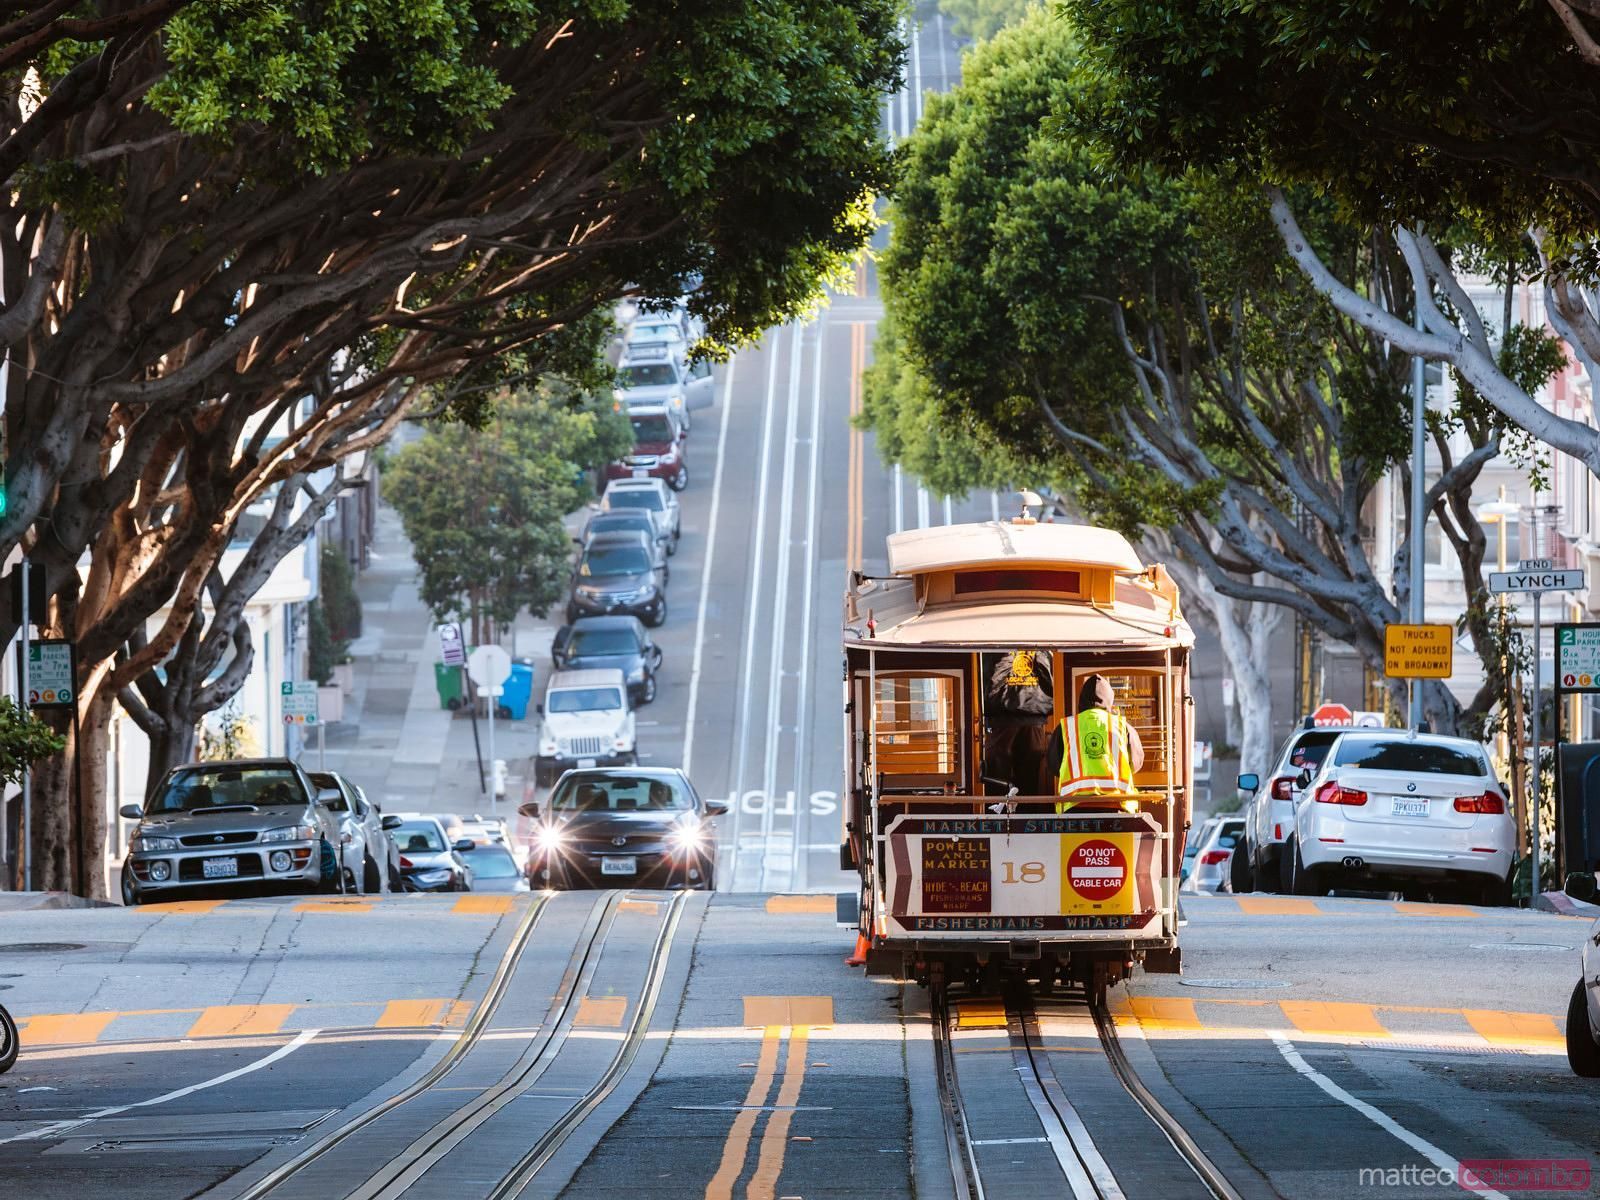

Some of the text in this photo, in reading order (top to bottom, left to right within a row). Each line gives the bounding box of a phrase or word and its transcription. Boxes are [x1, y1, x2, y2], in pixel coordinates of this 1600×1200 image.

[1526, 560, 1549, 568] END
[1507, 575, 1565, 588] LYNCH
[1403, 630, 1435, 639] TRUCKS
[1563, 630, 1573, 643] 2
[1390, 645, 1447, 654] NOT ADVISED
[1387, 660, 1449, 670] ON BROADWAY
[924, 820, 1003, 832] MARKET
[1024, 819, 1105, 832] STREET
[926, 842, 988, 852] POWELL
[1079, 848, 1116, 857] DO NOT
[925, 859, 989, 869] MARKET
[1085, 857, 1110, 866] PASS
[1001, 861, 1046, 884] 18
[960, 881, 988, 893] BEACH
[1073, 879, 1122, 888] CABLE CAR
[917, 917, 1131, 929] FISHERMANS WHARF
